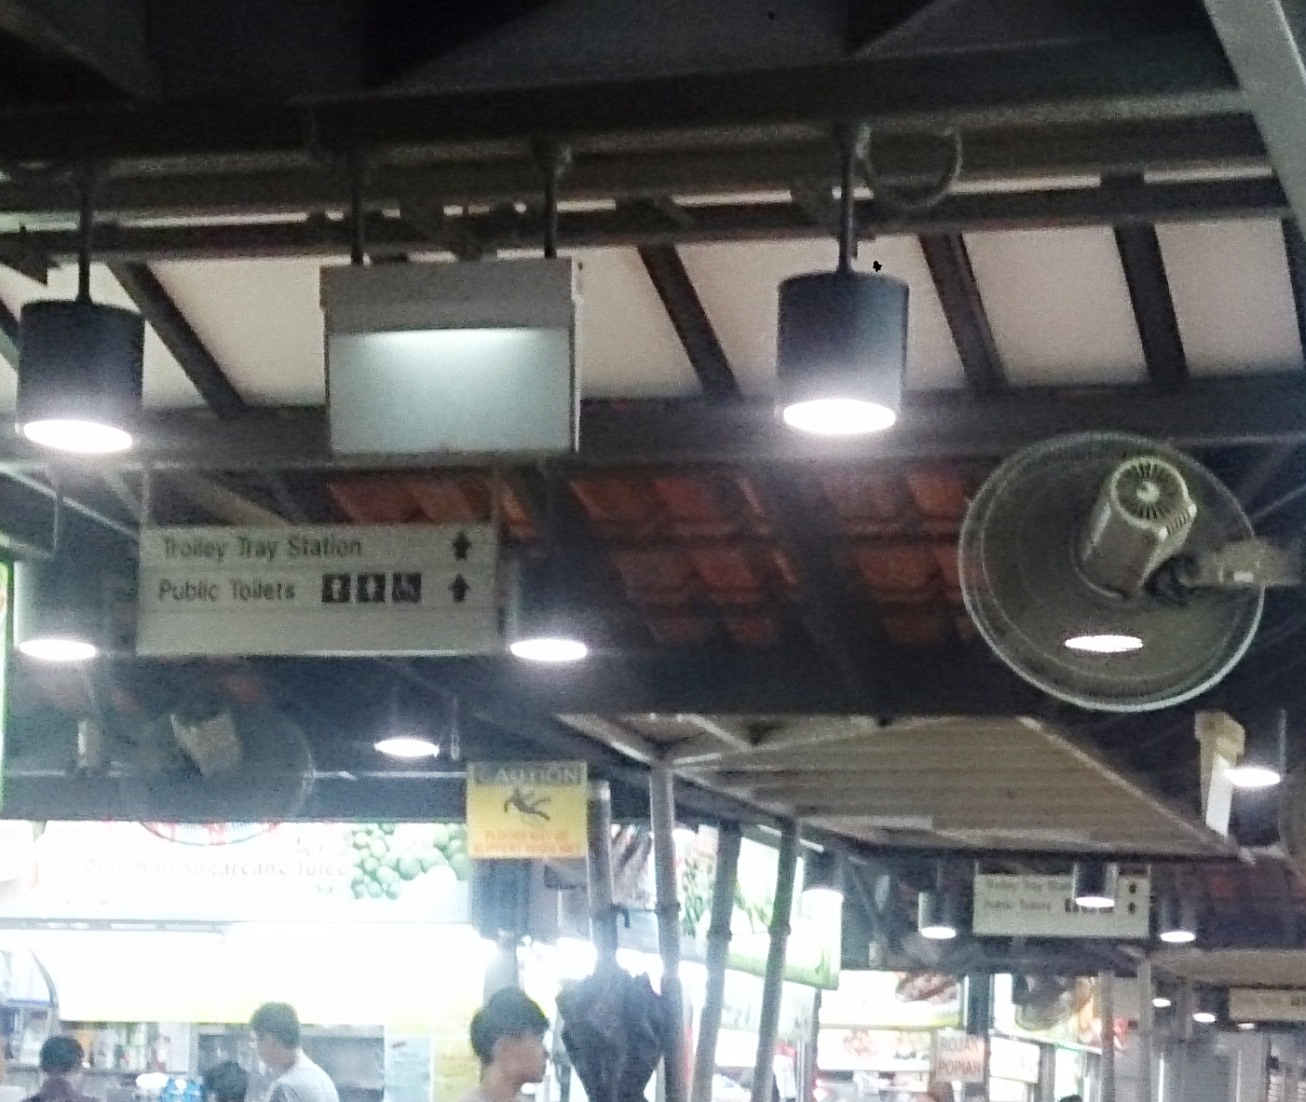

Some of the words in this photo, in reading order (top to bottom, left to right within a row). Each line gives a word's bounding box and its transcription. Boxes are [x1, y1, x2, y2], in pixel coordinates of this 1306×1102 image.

[162, 534, 227, 562] Trolley
[238, 535, 278, 562] Tray
[287, 533, 362, 558] Station
[158, 578, 219, 602] Public
[230, 578, 295, 602] Toilets
